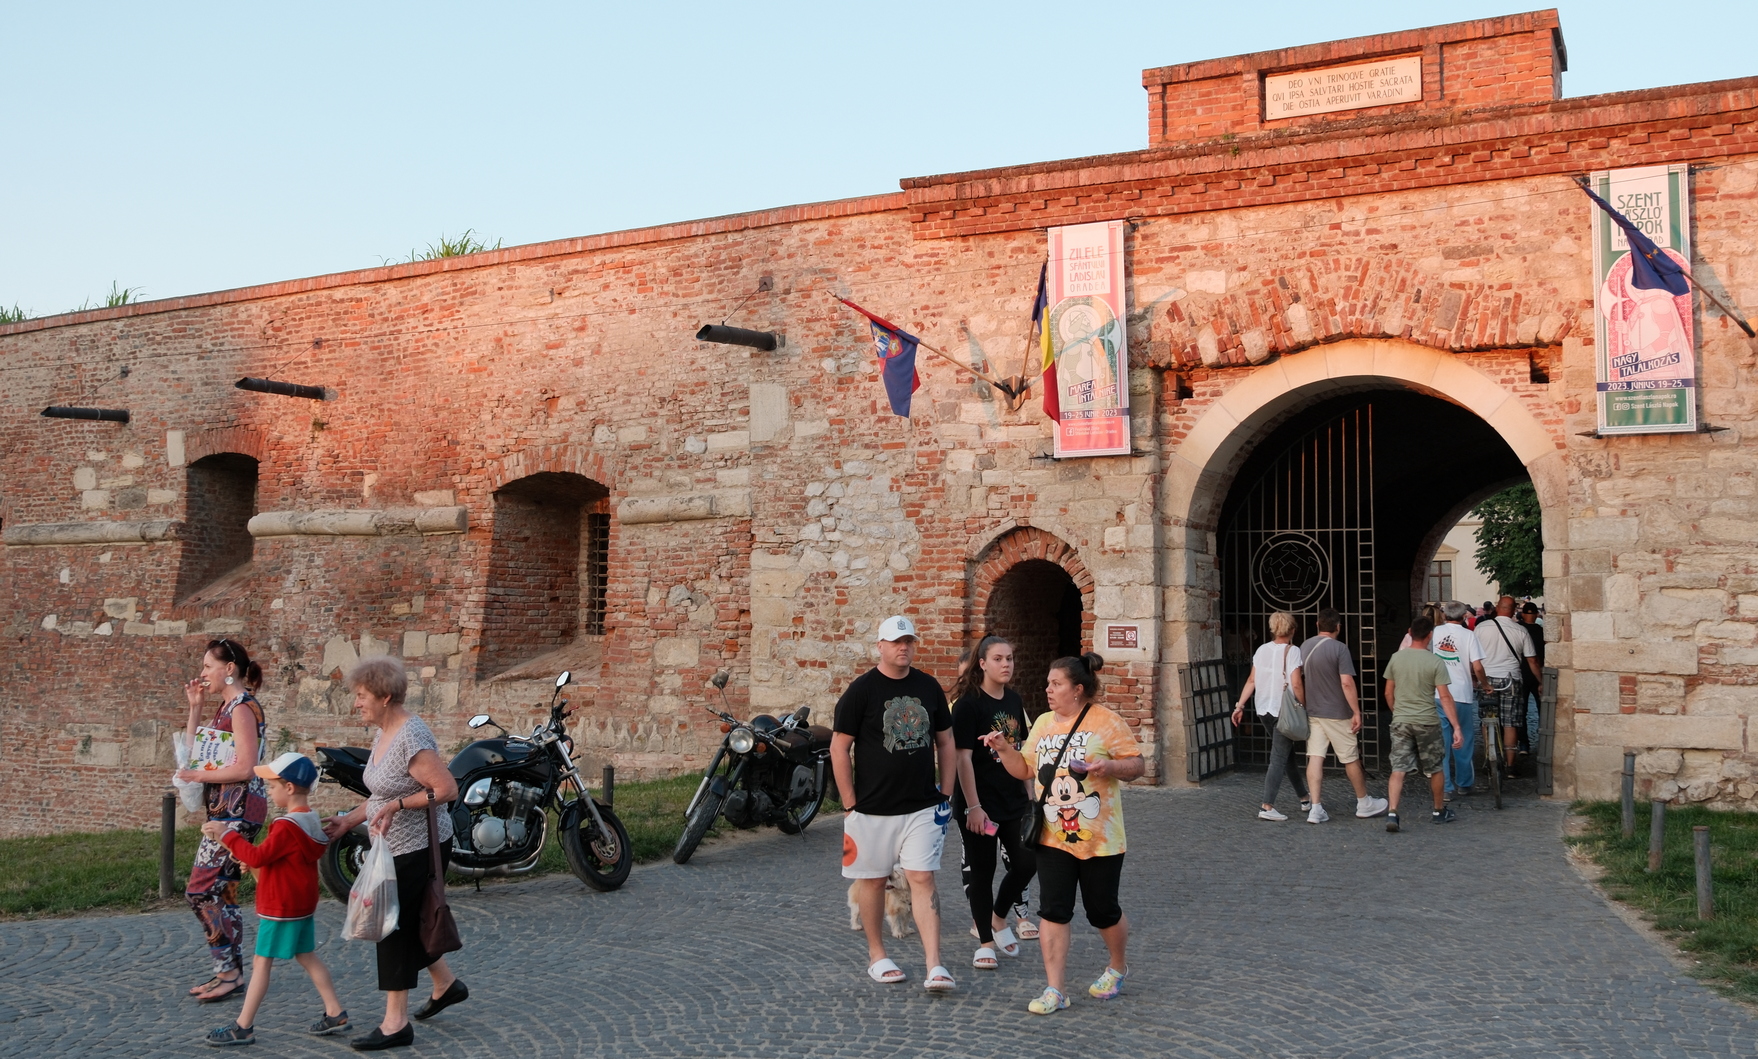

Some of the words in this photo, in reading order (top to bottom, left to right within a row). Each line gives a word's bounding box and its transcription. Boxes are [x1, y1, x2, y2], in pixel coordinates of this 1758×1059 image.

[1288, 78, 1304, 89] DEO
[1308, 76, 1322, 86] VNI
[1326, 70, 1364, 83] TRINOQVE
[1369, 66, 1396, 78] GRATIE
[1272, 92, 1285, 102] QVI
[1289, 90, 1305, 99] IPSA
[1310, 84, 1345, 97] SALVTARI
[1380, 75, 1414, 87] SACRATA
[1282, 101, 1294, 111] DIE
[1299, 97, 1320, 109] OSTIA
[1326, 92, 1361, 106] APERUVIT
[1367, 88, 1403, 100] VARADINI
[1617, 192, 1662, 209] SZENT
[1617, 206, 1663, 221] ÁSZLÓ
[1618, 220, 1663, 236] POK
[1069, 246, 1104, 260] ZILELE
[1070, 270, 1105, 282] LADISLAU
[1070, 281, 1106, 292] ORADEA
[1614, 353, 1638, 367] NAGY
[1621, 352, 1678, 376] TALÁLKOZÁS
[1070, 381, 1096, 395] MAREA
[1629, 380, 1655, 392] JÚNIUS
